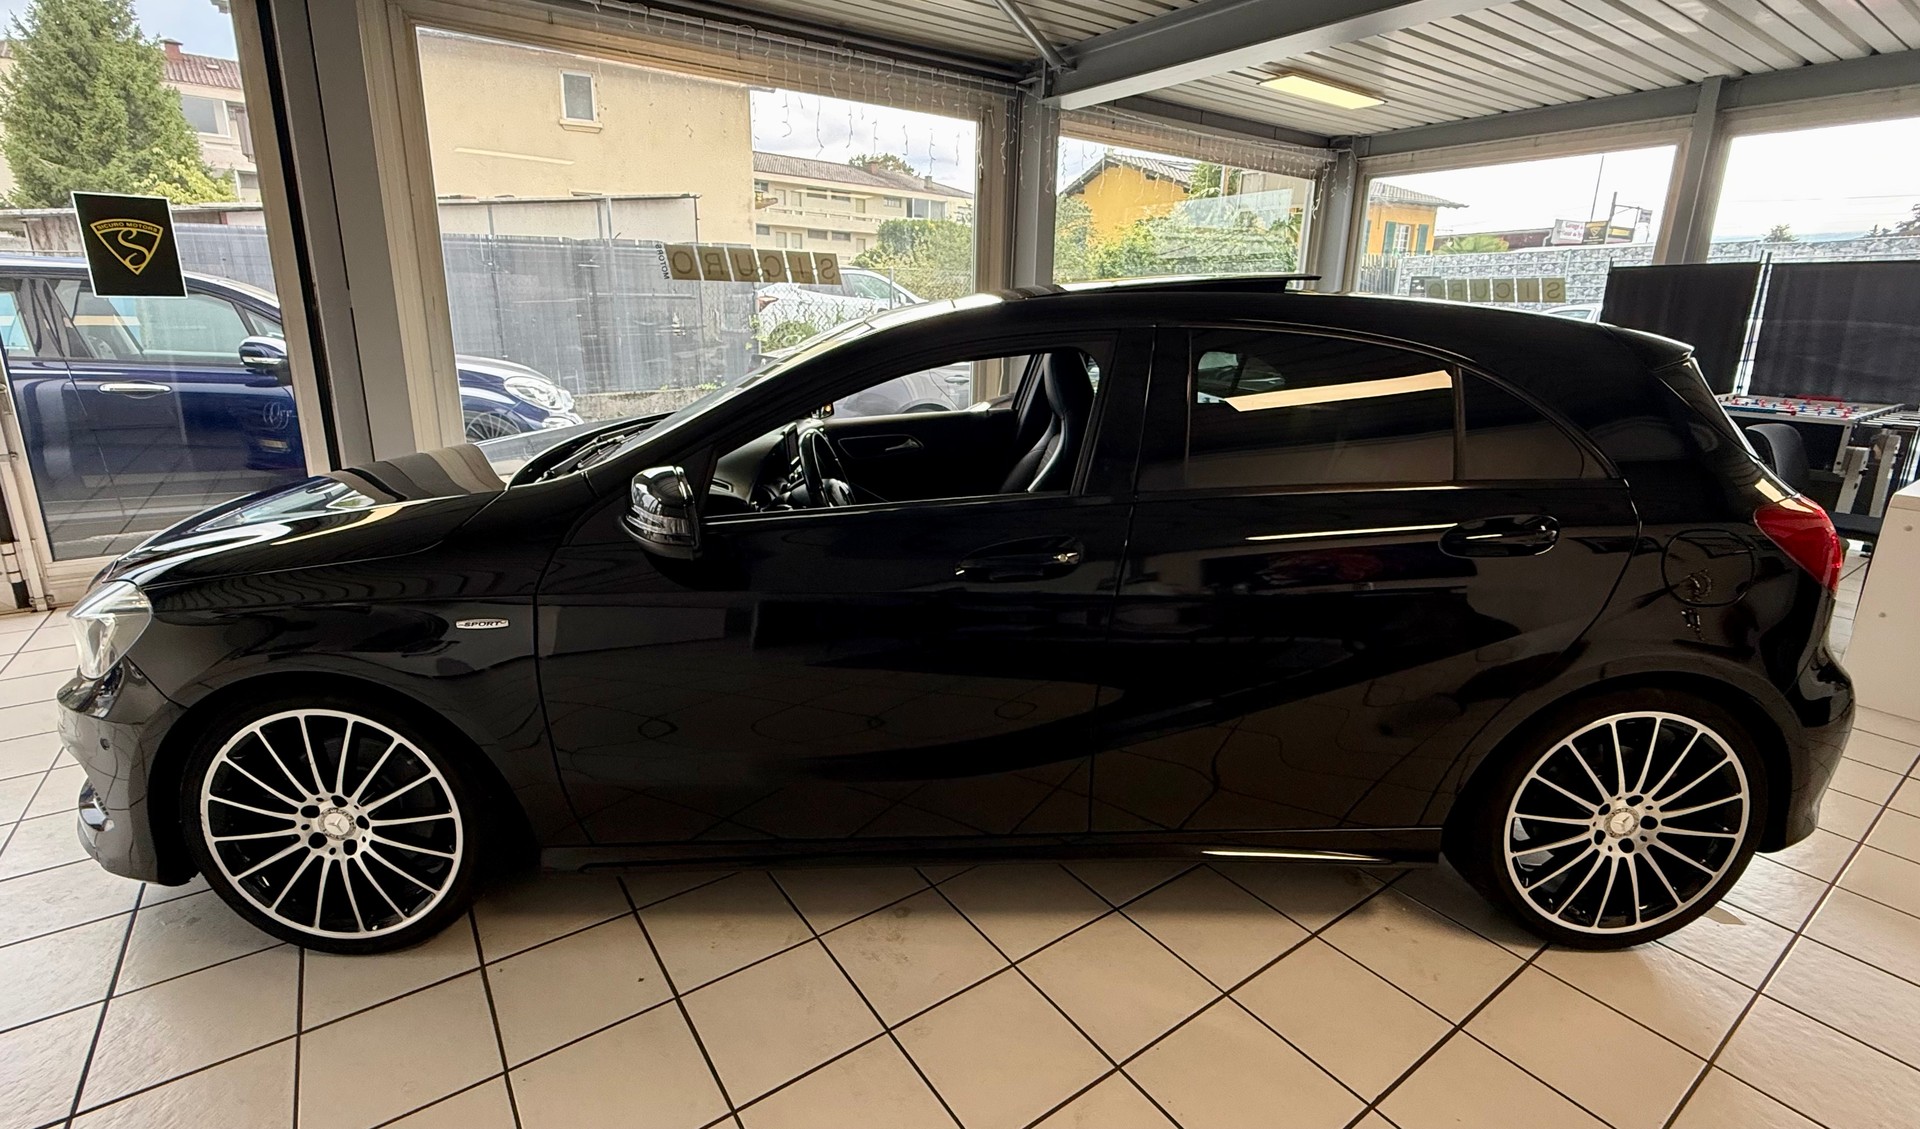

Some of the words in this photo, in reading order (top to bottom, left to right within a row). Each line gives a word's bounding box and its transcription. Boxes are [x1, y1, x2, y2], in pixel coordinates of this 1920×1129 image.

[96, 222, 124, 230] SICURO
[126, 222, 158, 232] MOTORS
[118, 228, 149, 268] S
